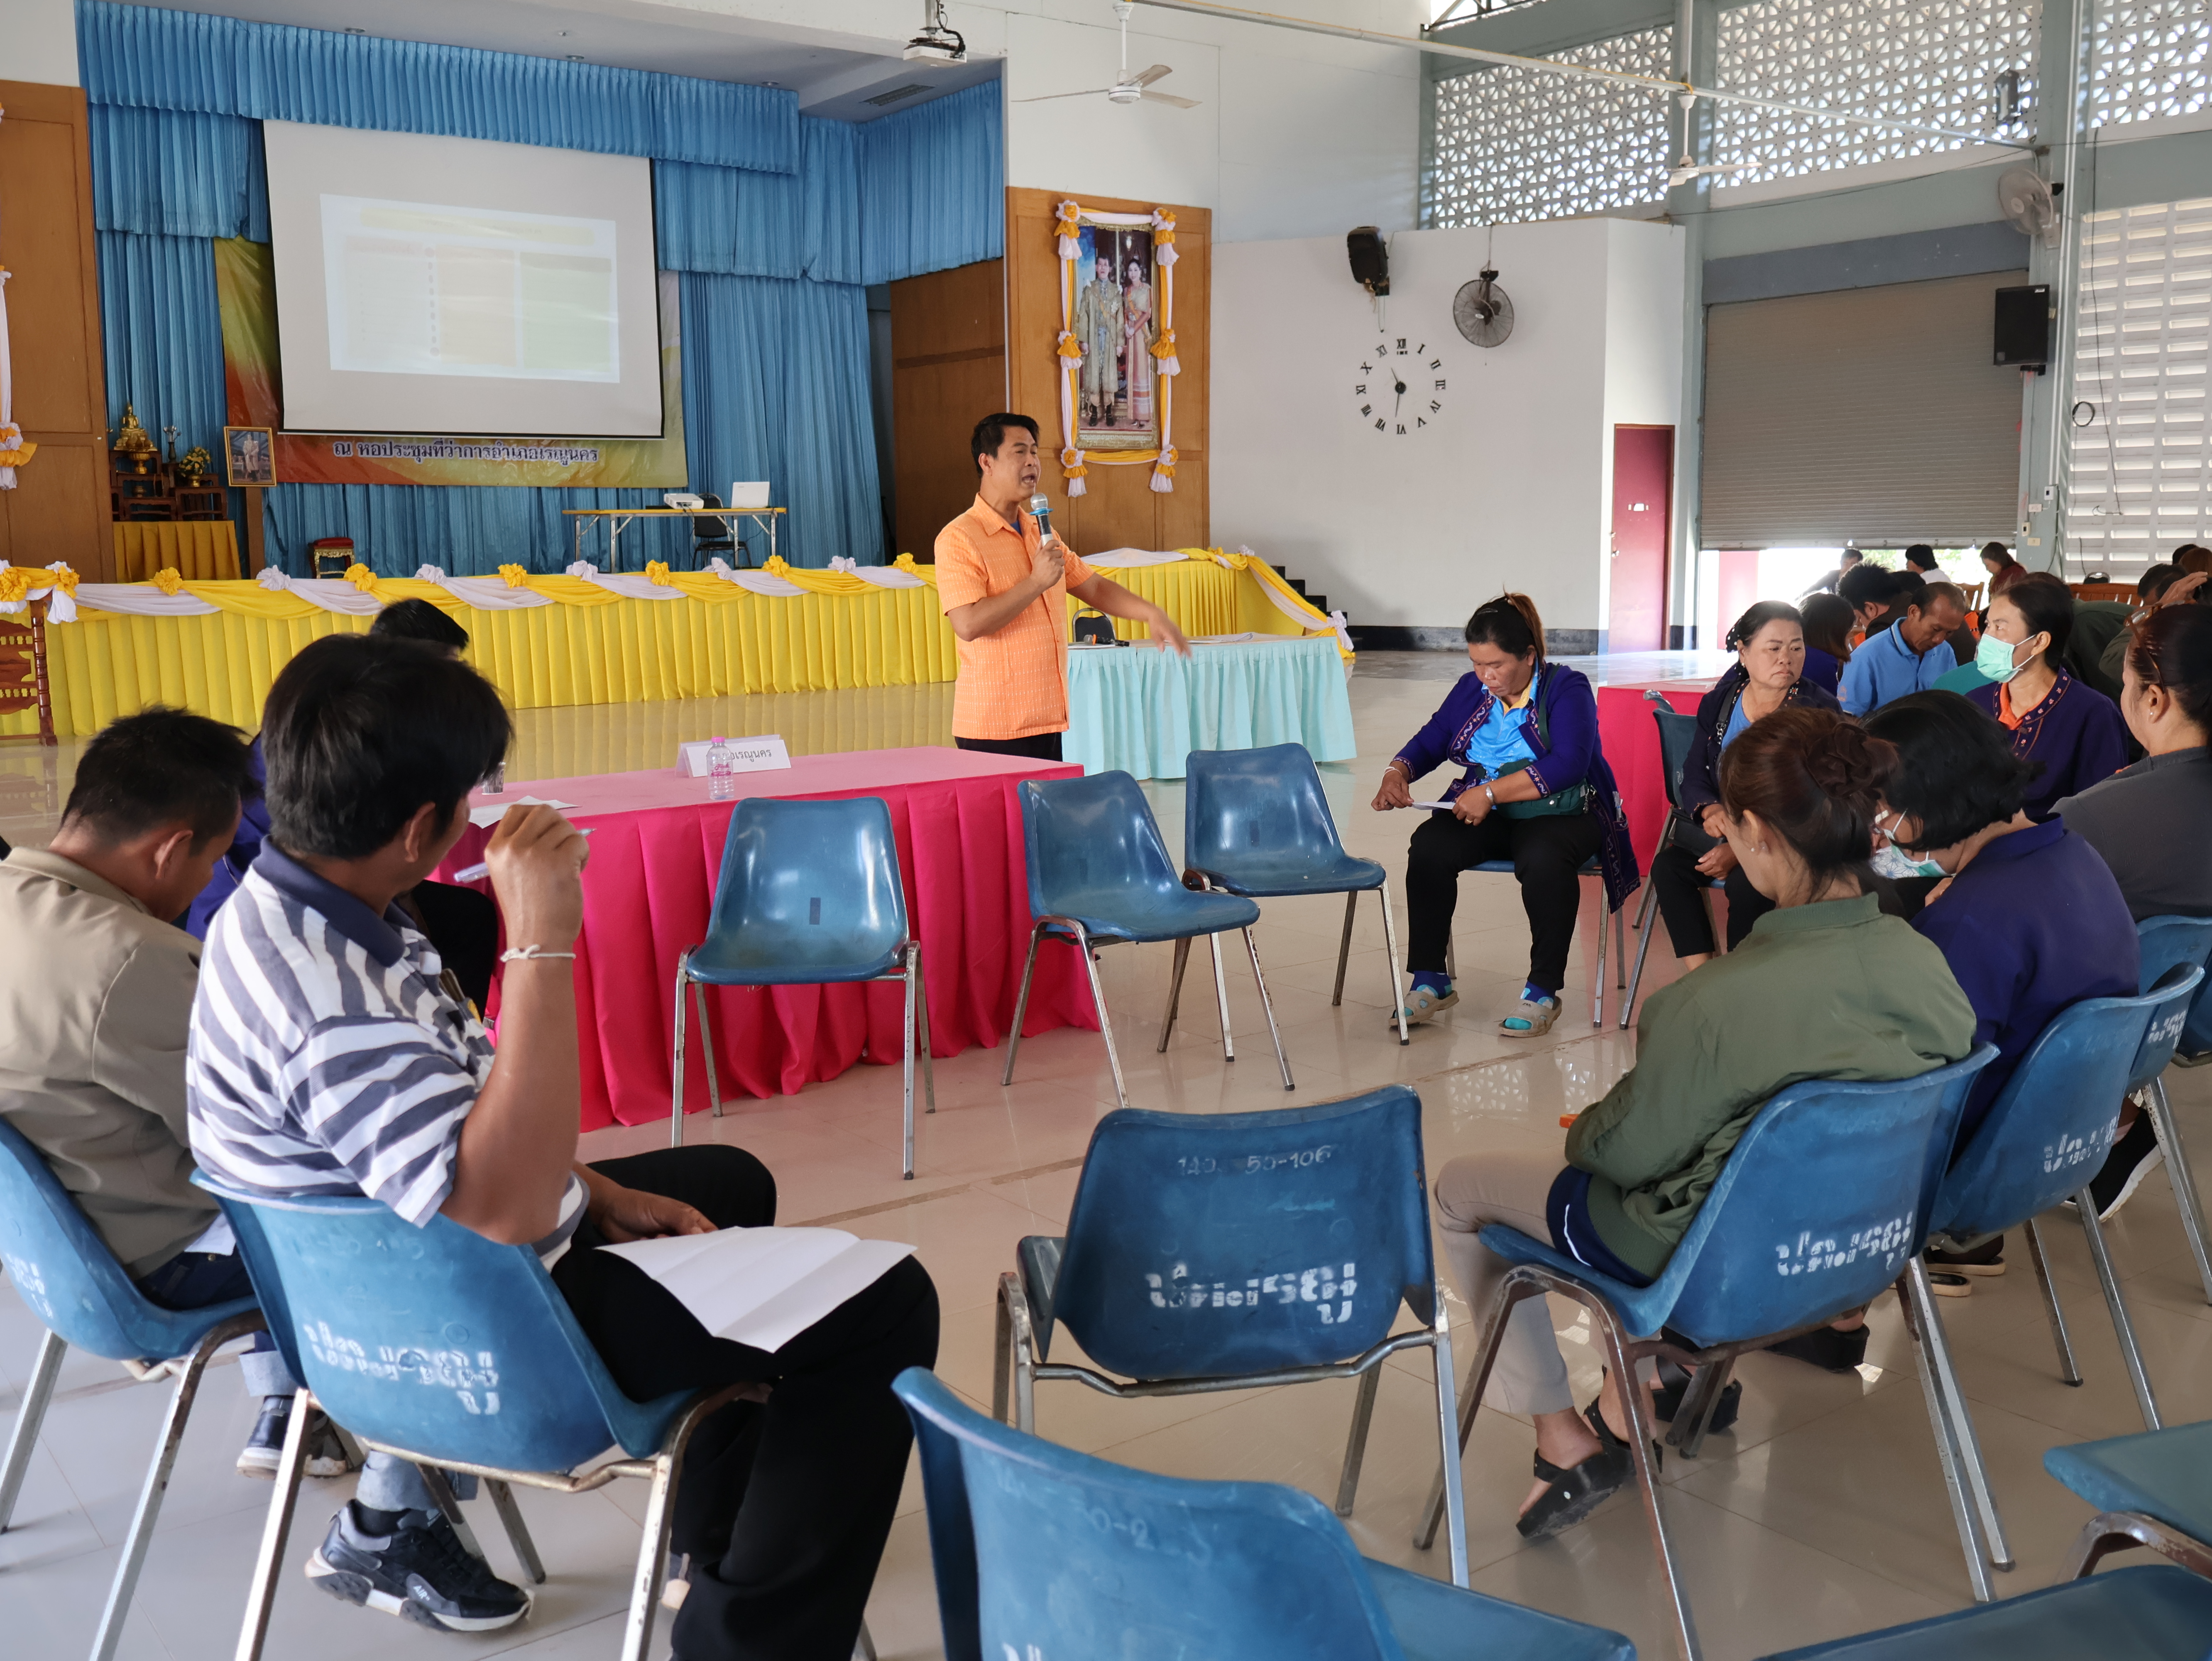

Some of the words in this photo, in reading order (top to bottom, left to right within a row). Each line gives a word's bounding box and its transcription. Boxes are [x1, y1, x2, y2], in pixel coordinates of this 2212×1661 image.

[1397, 338, 1406, 349] XII
[1417, 343, 1426, 355] I
[1360, 361, 1373, 375] X
[1430, 359, 1441, 370] II
[1356, 385, 1366, 395] IX
[1429, 399, 1441, 413] IV
[1417, 416, 1427, 428] V
[1397, 424, 1407, 435] VI
[333, 441, 352, 456] ณ
